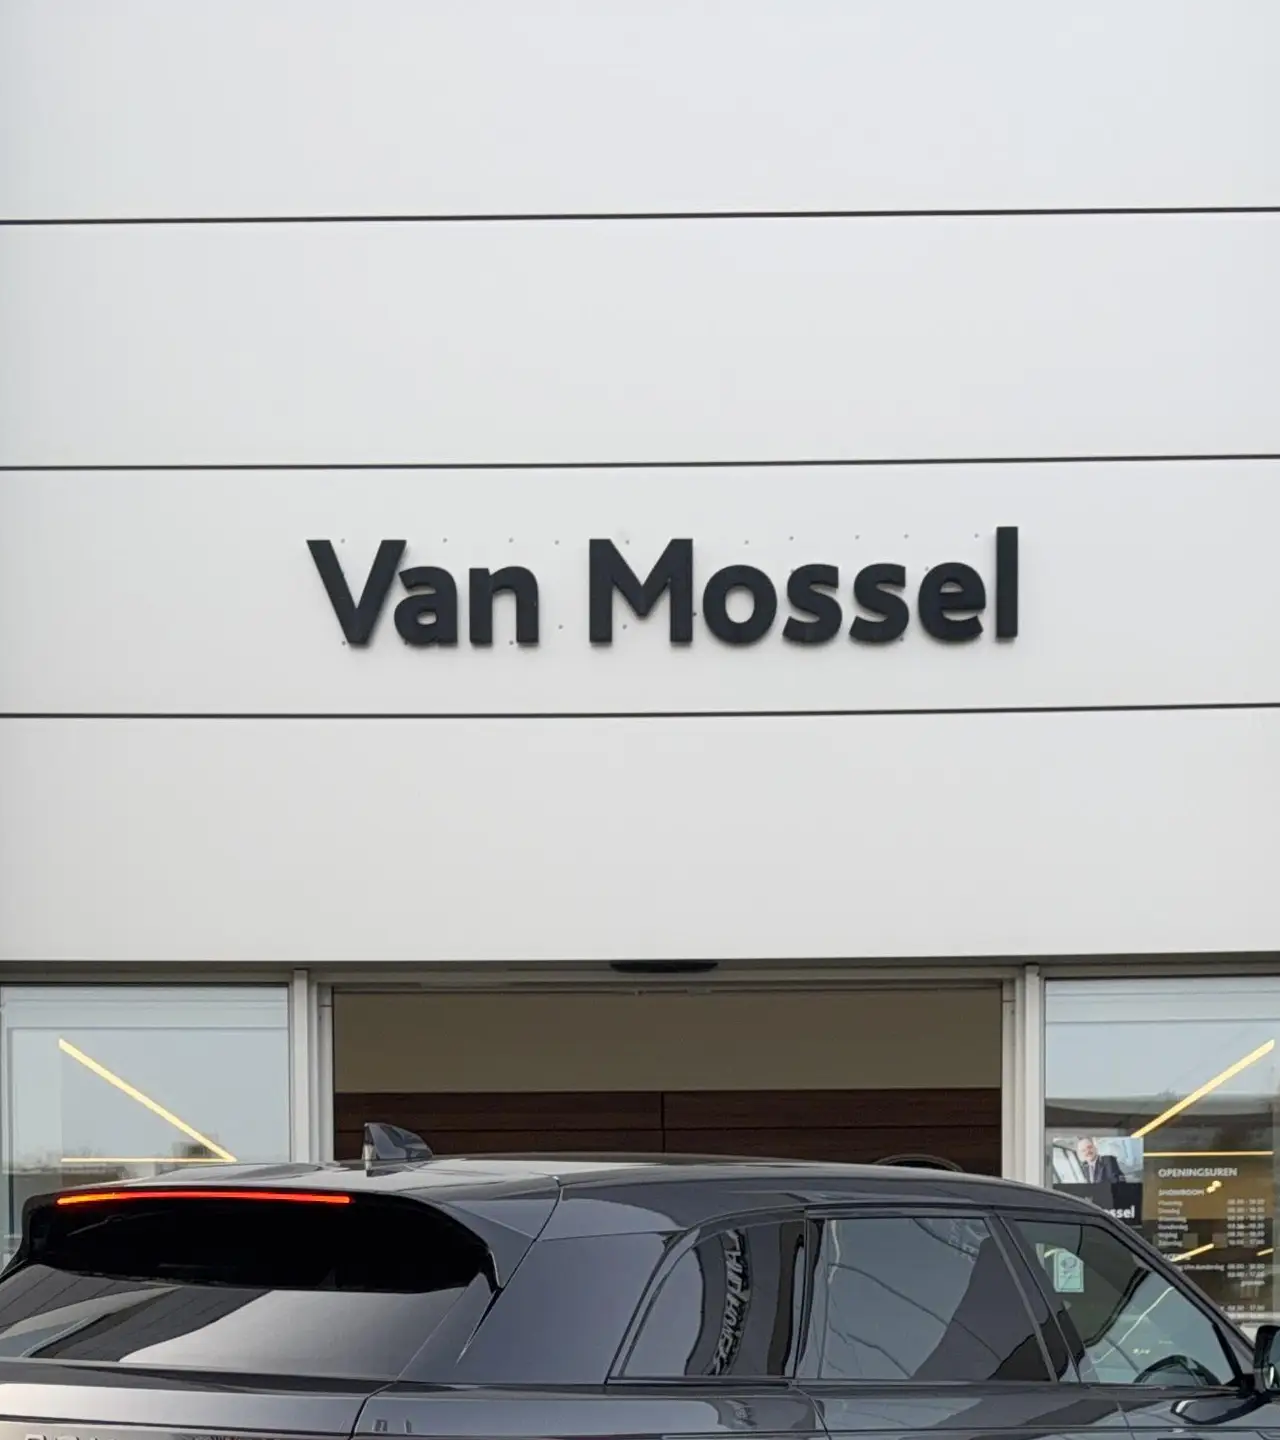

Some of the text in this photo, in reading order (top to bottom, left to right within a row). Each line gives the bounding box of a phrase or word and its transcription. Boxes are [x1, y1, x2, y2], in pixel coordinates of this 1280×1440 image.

[305, 525, 1019, 647] Van Mossel
[1157, 1167, 1238, 1178] OPENINGSUREN
[1104, 1204, 1136, 1219] ssel
